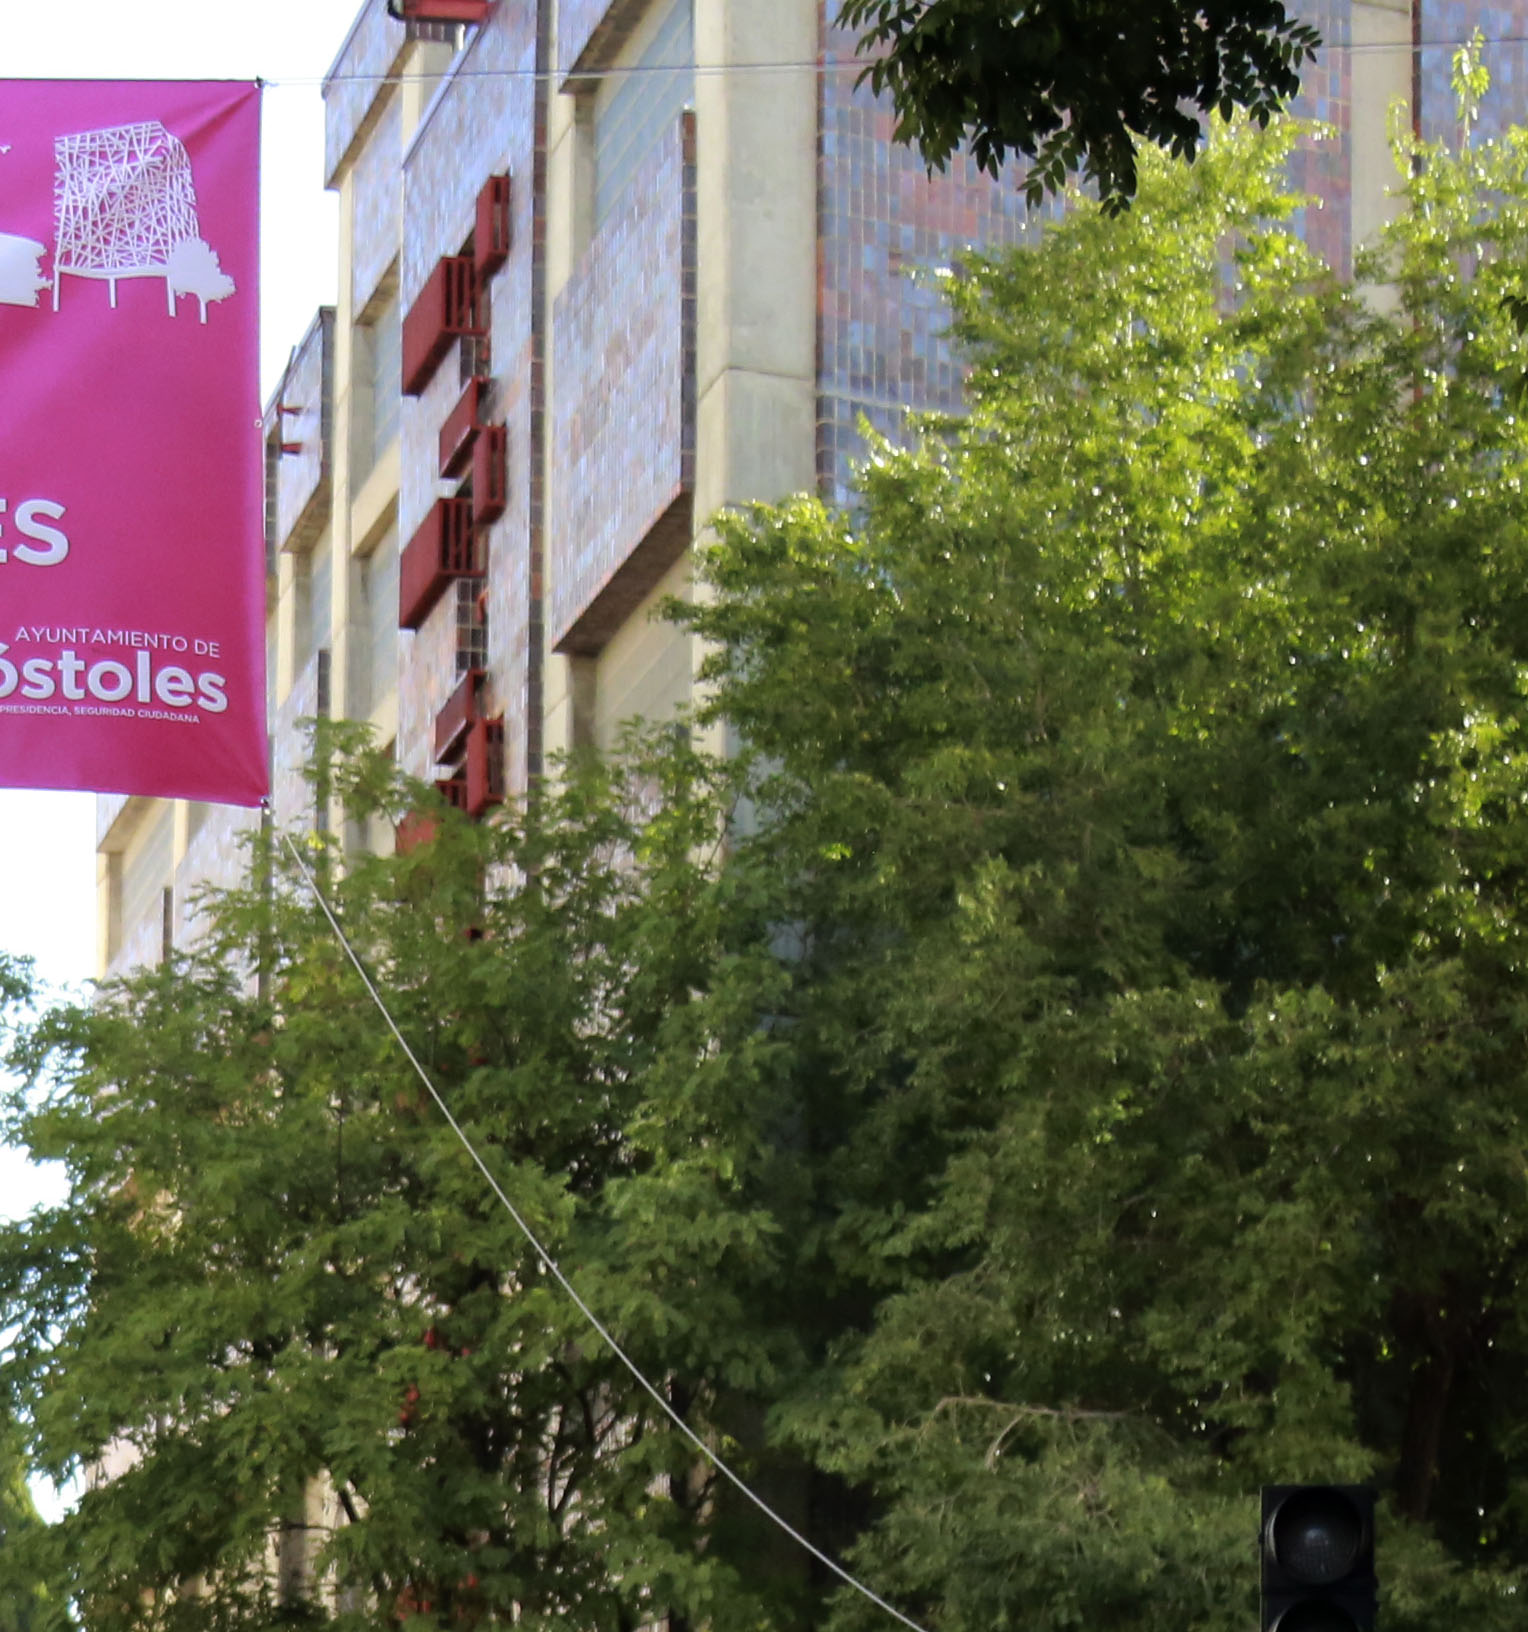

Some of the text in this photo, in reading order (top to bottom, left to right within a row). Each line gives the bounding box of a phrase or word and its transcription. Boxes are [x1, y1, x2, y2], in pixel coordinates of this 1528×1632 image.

[14, 625, 222, 659] AYUNTAMIENTO DE
[0, 704, 72, 717] PRESIDENCIA,
[73, 705, 135, 717] SEGURIDAD
[137, 708, 201, 723] CIUDADANA
